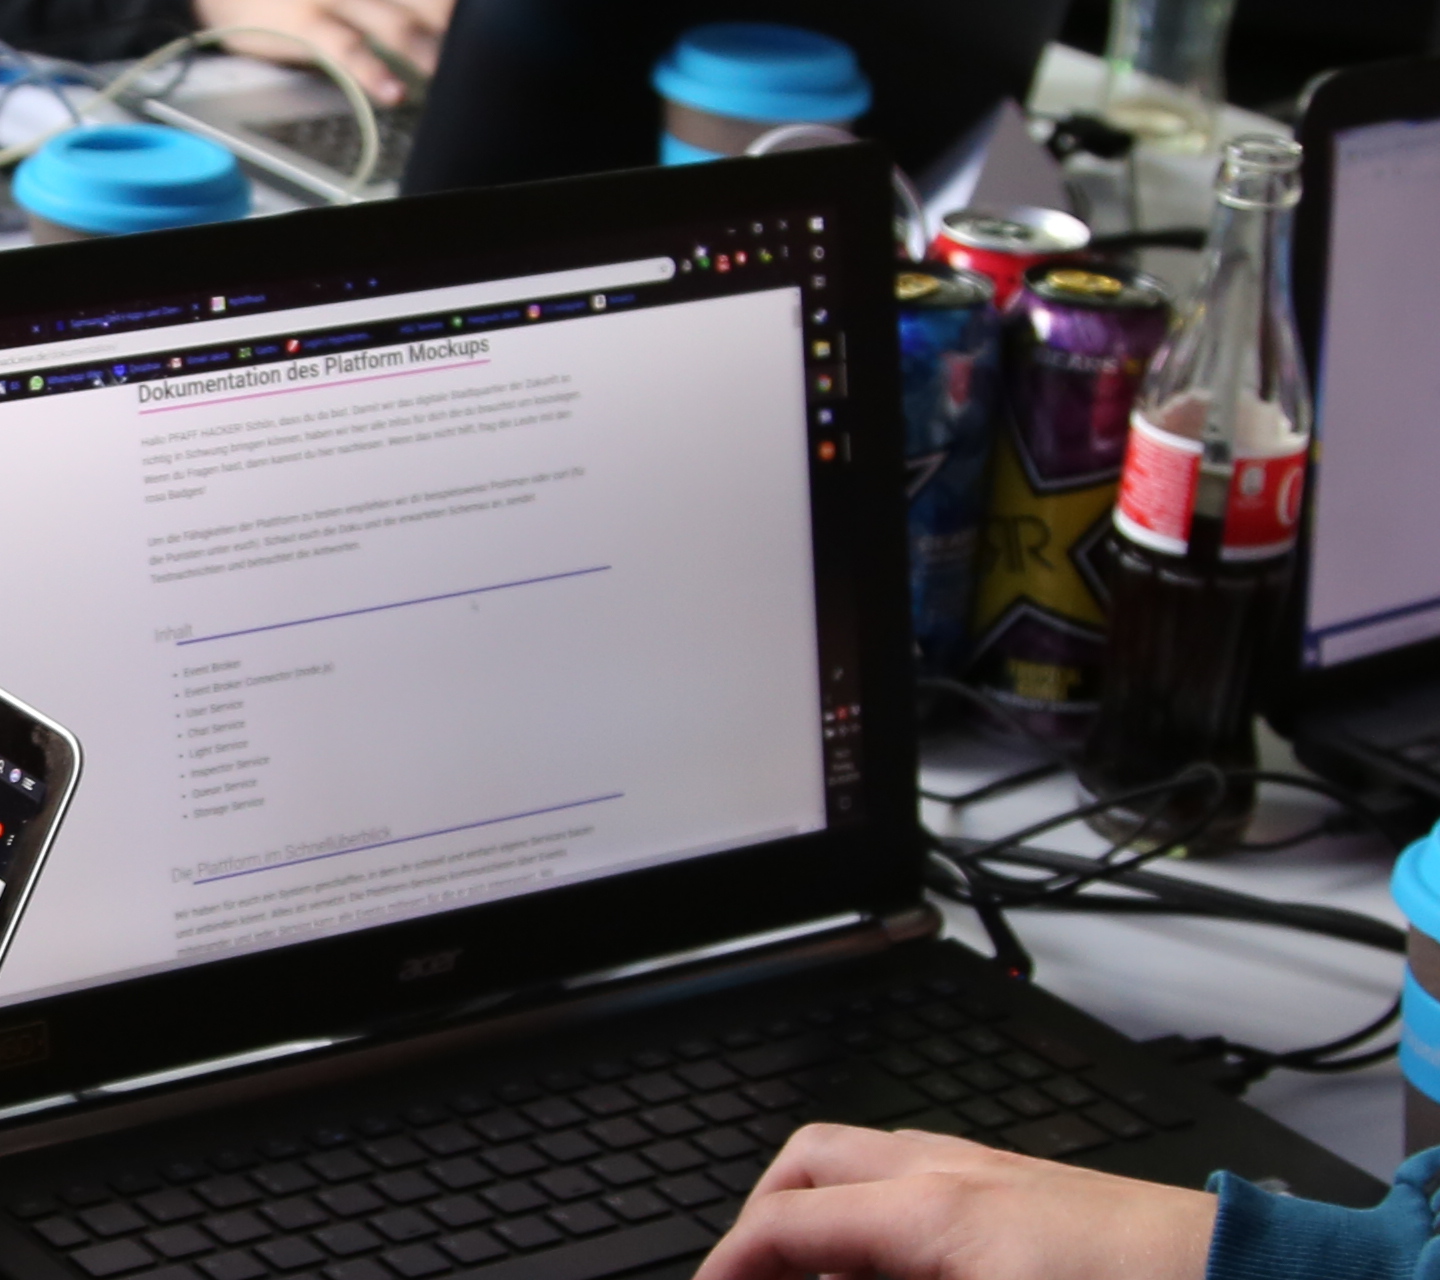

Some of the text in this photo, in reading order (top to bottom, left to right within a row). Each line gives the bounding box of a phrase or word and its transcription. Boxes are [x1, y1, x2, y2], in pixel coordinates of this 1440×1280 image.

[137, 334, 489, 405] Dokumentation des Platform Mockups
[153, 621, 193, 644] Inhalt
